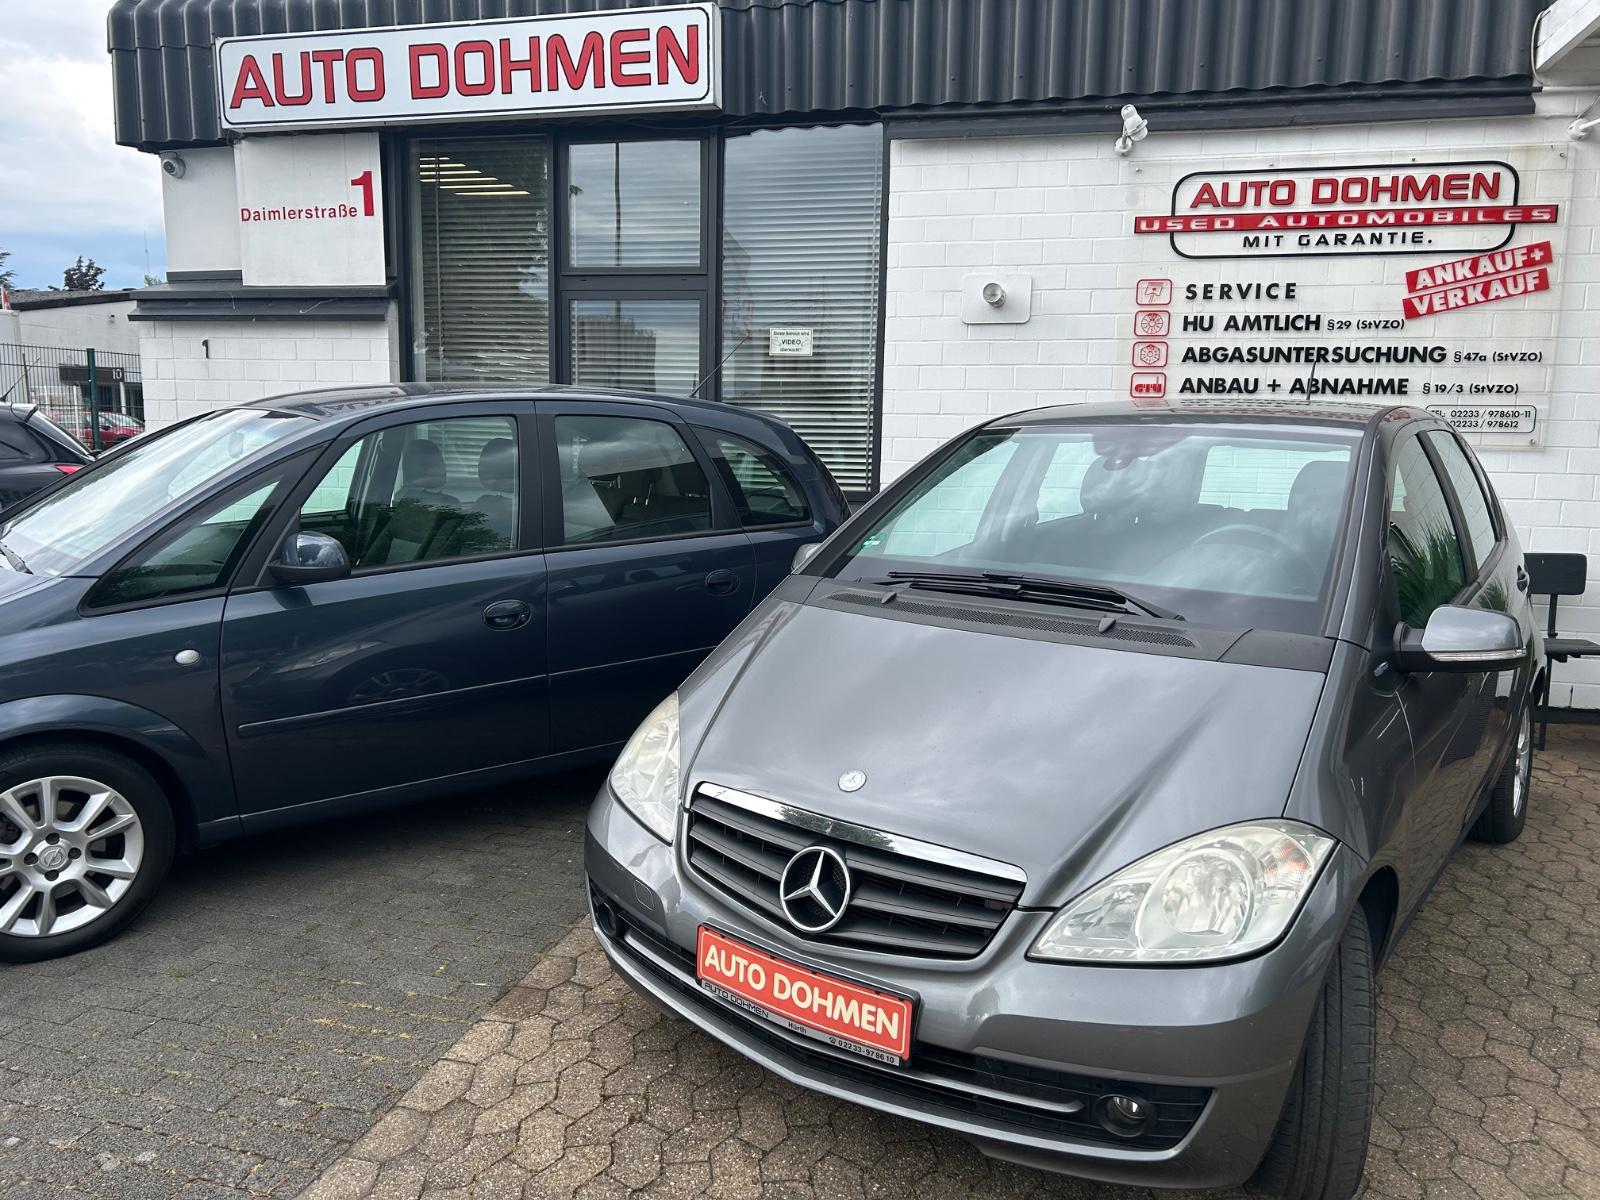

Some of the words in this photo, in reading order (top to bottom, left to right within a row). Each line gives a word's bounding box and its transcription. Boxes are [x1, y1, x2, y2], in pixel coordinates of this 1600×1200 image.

[229, 47, 385, 109] AUTO
[409, 24, 700, 100] DOHMEN
[241, 204, 357, 222] Daimlerstraße
[351, 171, 374, 217] 1
[1190, 178, 1296, 209] AUTO
[1311, 172, 1501, 205] DOHMEN
[1139, 217, 1236, 232] USED
[1257, 207, 1552, 228] AUTOMOBILES
[1242, 234, 1284, 248] MIT
[1297, 231, 1433, 247] GARANTIE.
[1185, 282, 1297, 300] SERVICE
[1411, 271, 1540, 315] VERKAUF
[1183, 315, 1214, 332] HU
[1223, 314, 1321, 331] AMTLICH
[1356, 318, 1405, 331] (StVZO)
[201, 339, 209, 359] 1
[1181, 346, 1447, 363] ABGASUNTERSUCHUNG
[1492, 351, 1543, 363] (StVZO)
[1180, 377, 1259, 394] ANBAU
[1267, 378, 1281, 393] +
[1289, 377, 1409, 395] ABNAHME
[1469, 382, 1519, 395] (StVZO)
[704, 944, 766, 991] AUTO
[773, 972, 900, 1040] DOHMEN
[704, 982, 729, 999] AUTO
[730, 995, 769, 1018] DOHMEN
